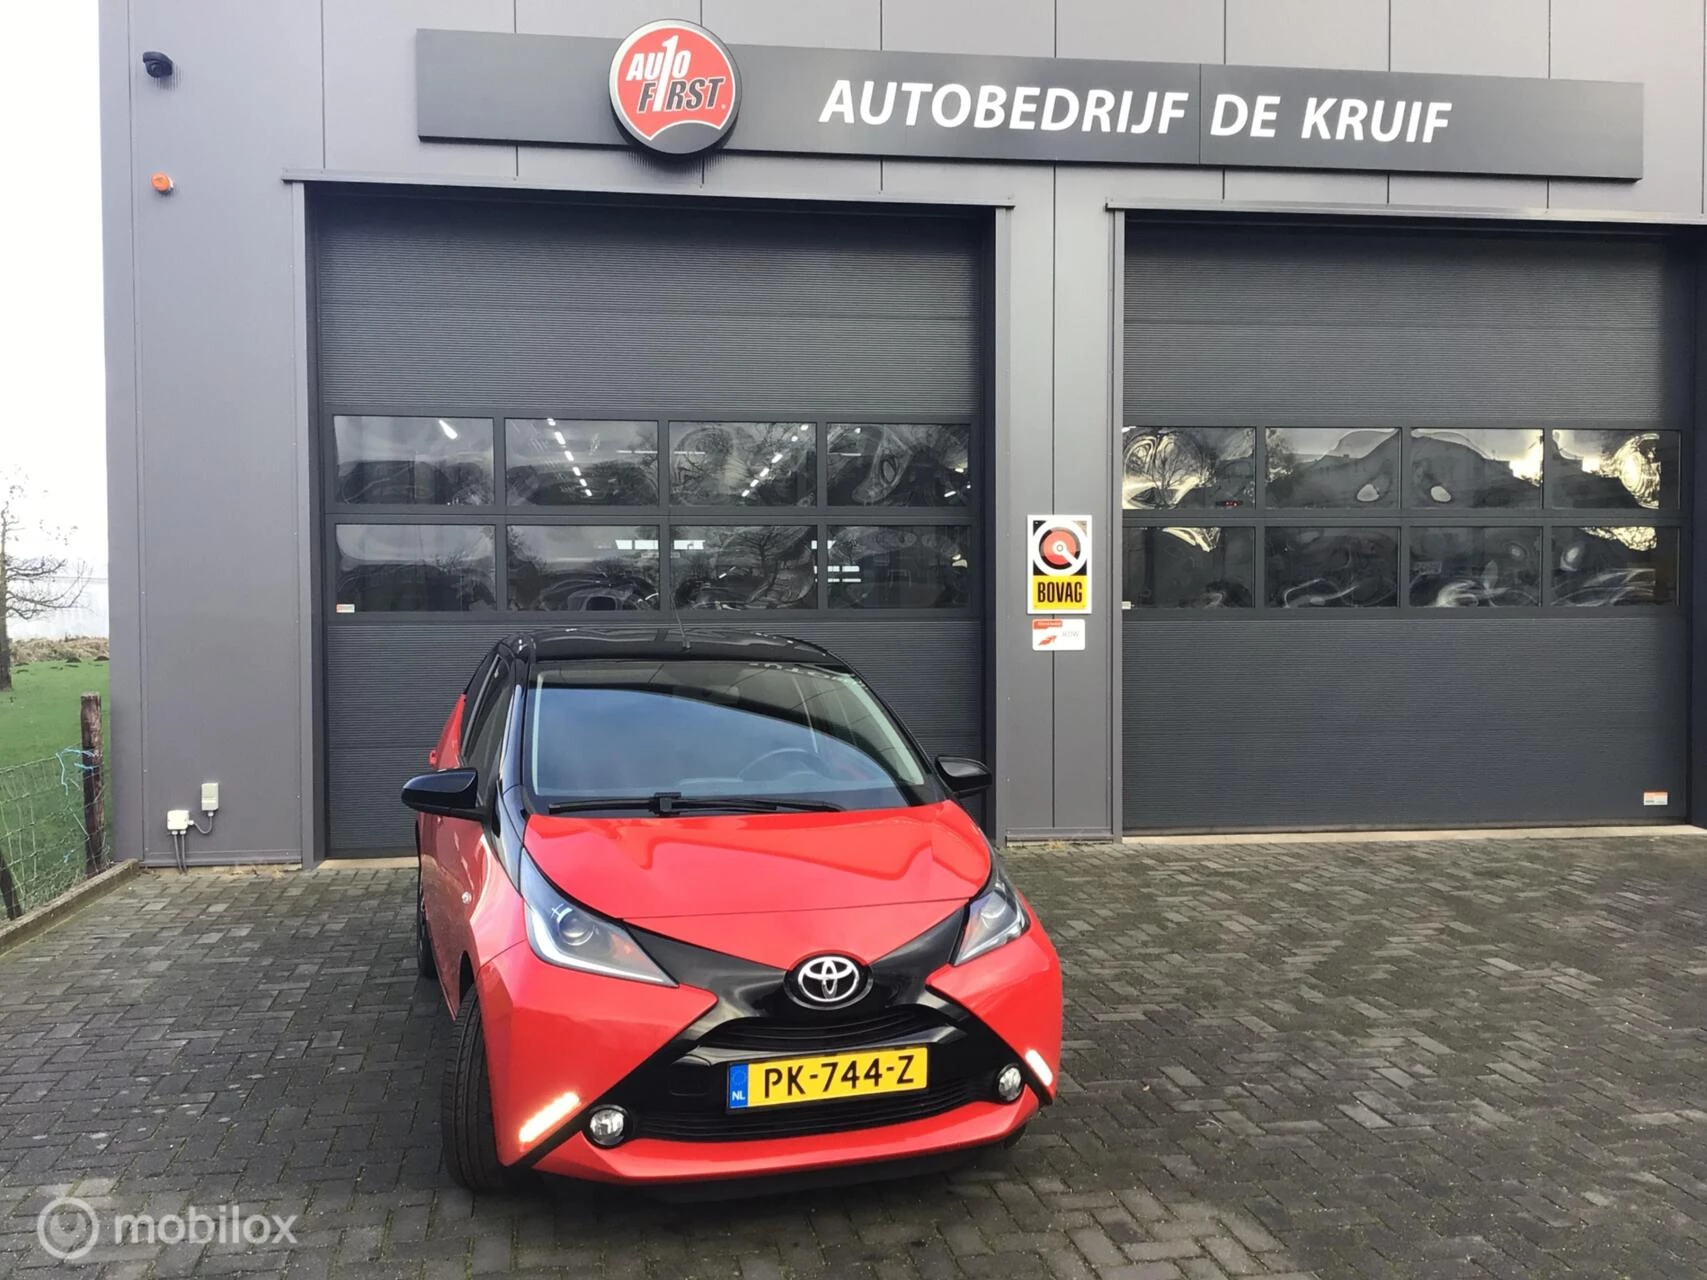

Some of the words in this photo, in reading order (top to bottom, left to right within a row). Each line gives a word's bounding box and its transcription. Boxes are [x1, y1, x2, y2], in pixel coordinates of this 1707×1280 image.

[818, 79, 1189, 134] AUTOBEDRIJF
[1210, 93, 1281, 138] DE
[1301, 97, 1453, 143] KRUIF
[1037, 581, 1083, 603] BOVAG
[764, 1054, 915, 1099] PK-744-Z
[731, 1090, 746, 1101] NL
